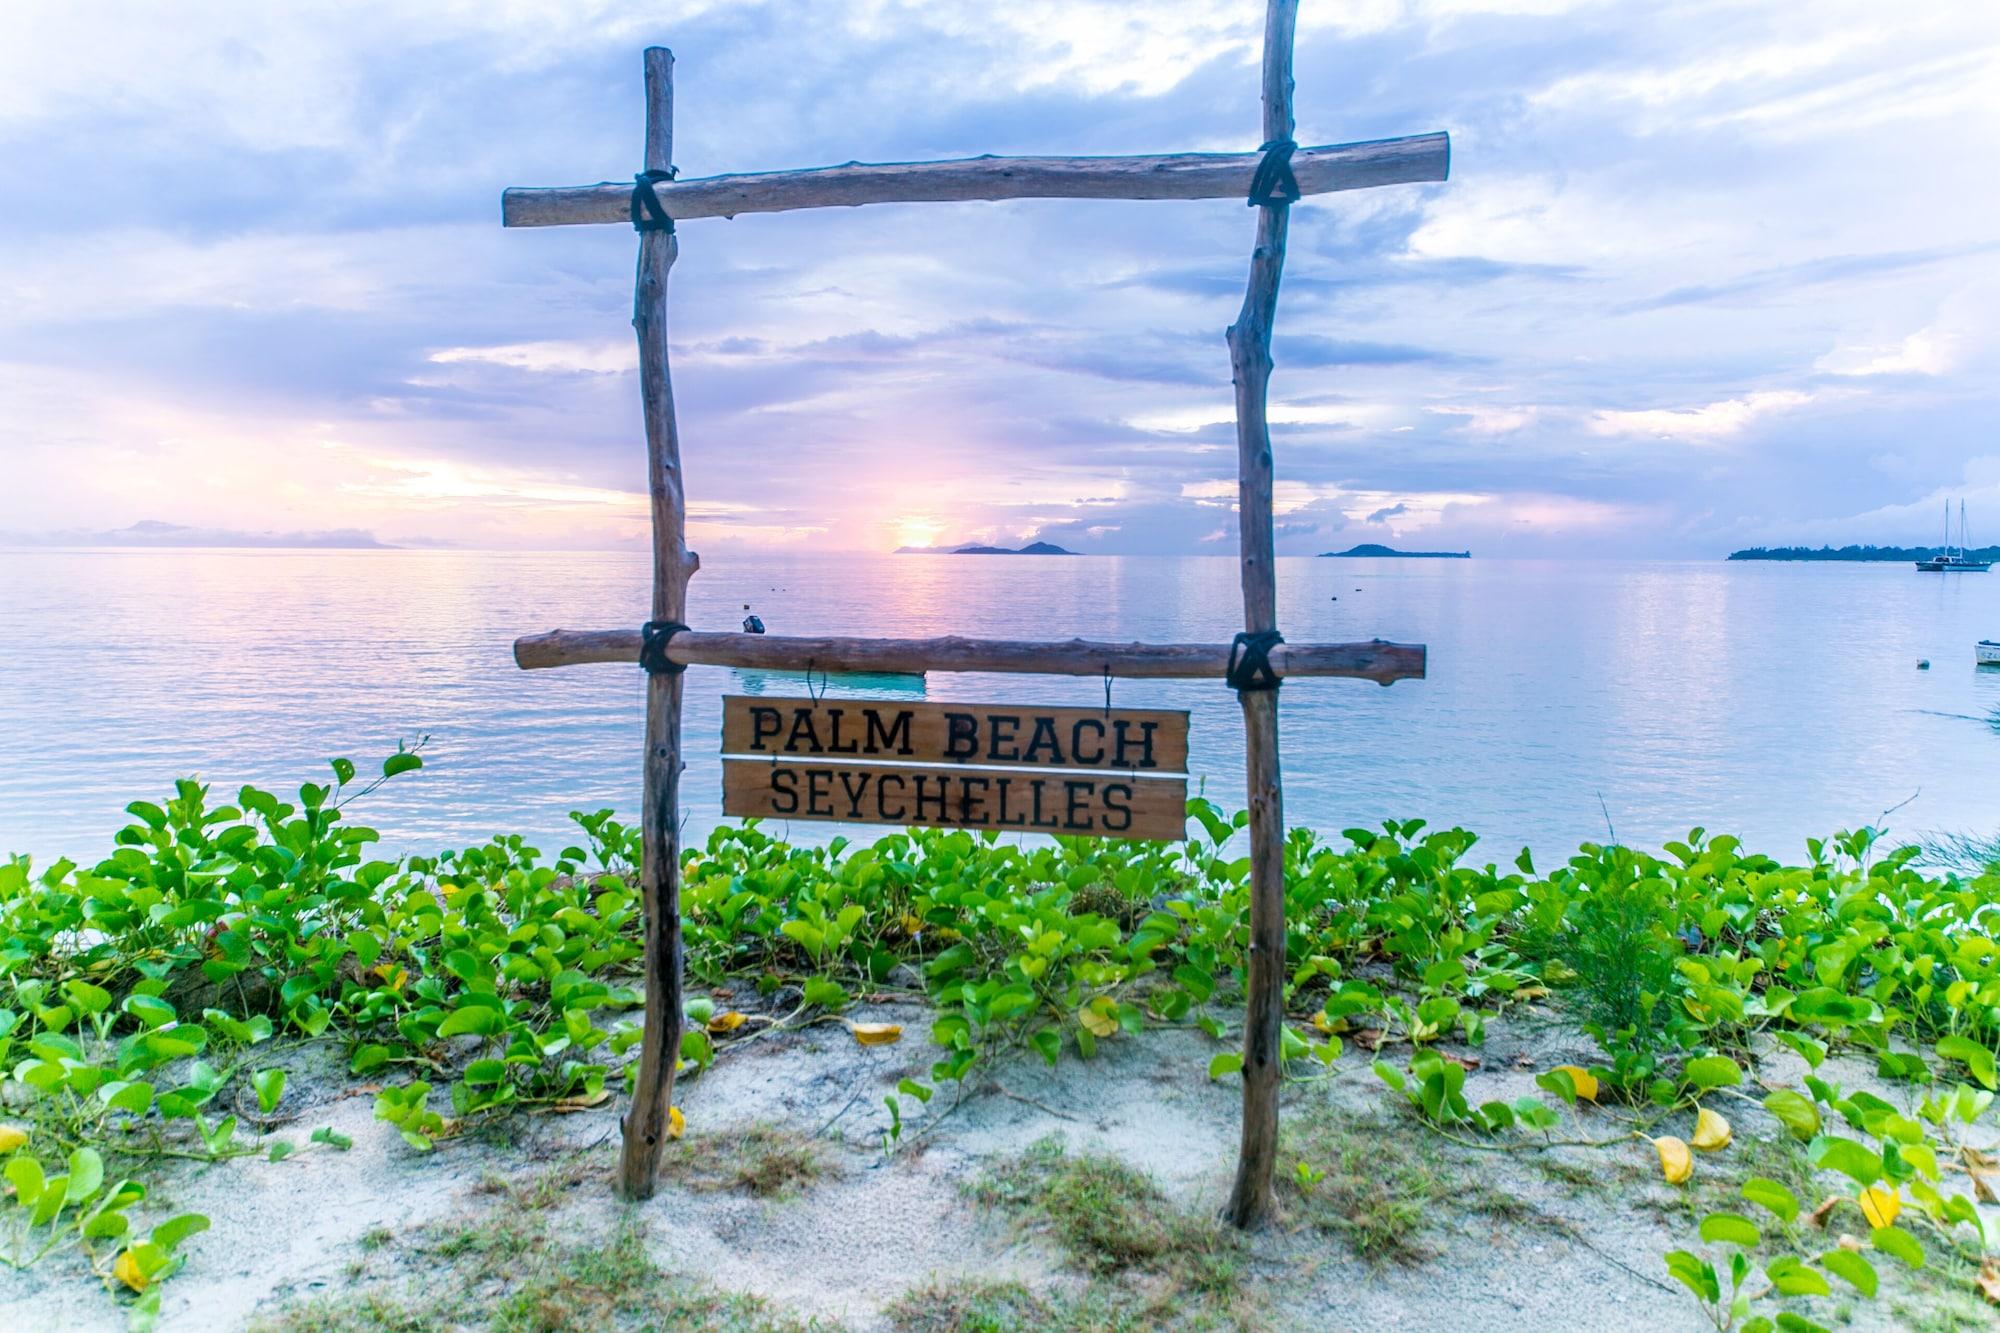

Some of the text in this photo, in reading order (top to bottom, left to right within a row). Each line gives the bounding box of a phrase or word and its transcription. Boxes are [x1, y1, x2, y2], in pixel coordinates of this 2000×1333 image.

[749, 707, 1158, 767] PALM BEACH
[770, 768, 1132, 831] SEYCHELLES
